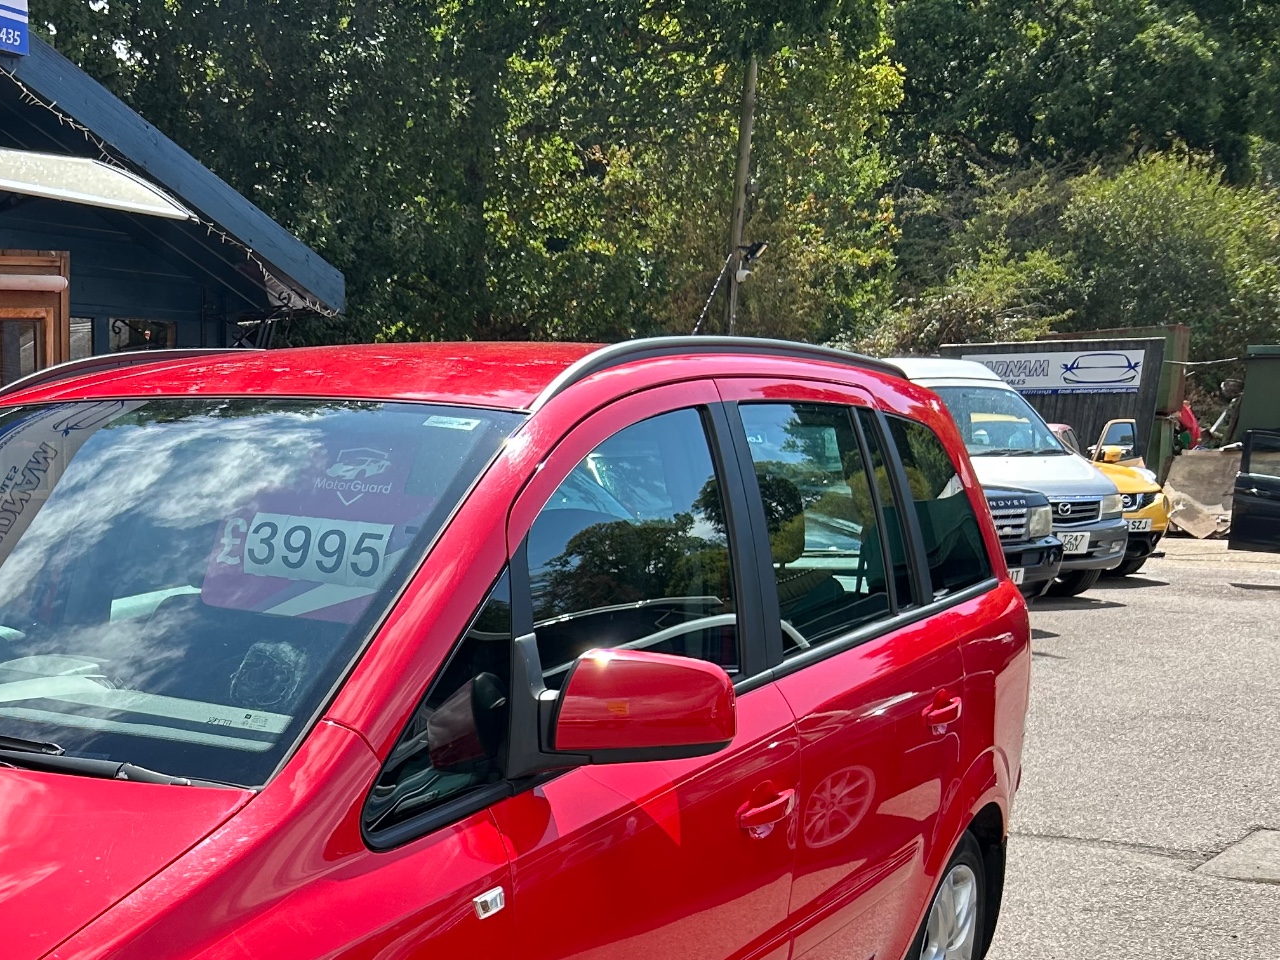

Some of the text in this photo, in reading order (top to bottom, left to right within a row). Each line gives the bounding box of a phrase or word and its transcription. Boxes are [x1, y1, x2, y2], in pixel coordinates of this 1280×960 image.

[314, 477, 393, 494] MotorGuard
[1131, 520, 1148, 530] SZJ
[1062, 534, 1085, 545] T247
[216, 517, 385, 578] £3995
[1063, 543, 1080, 551] SDX
